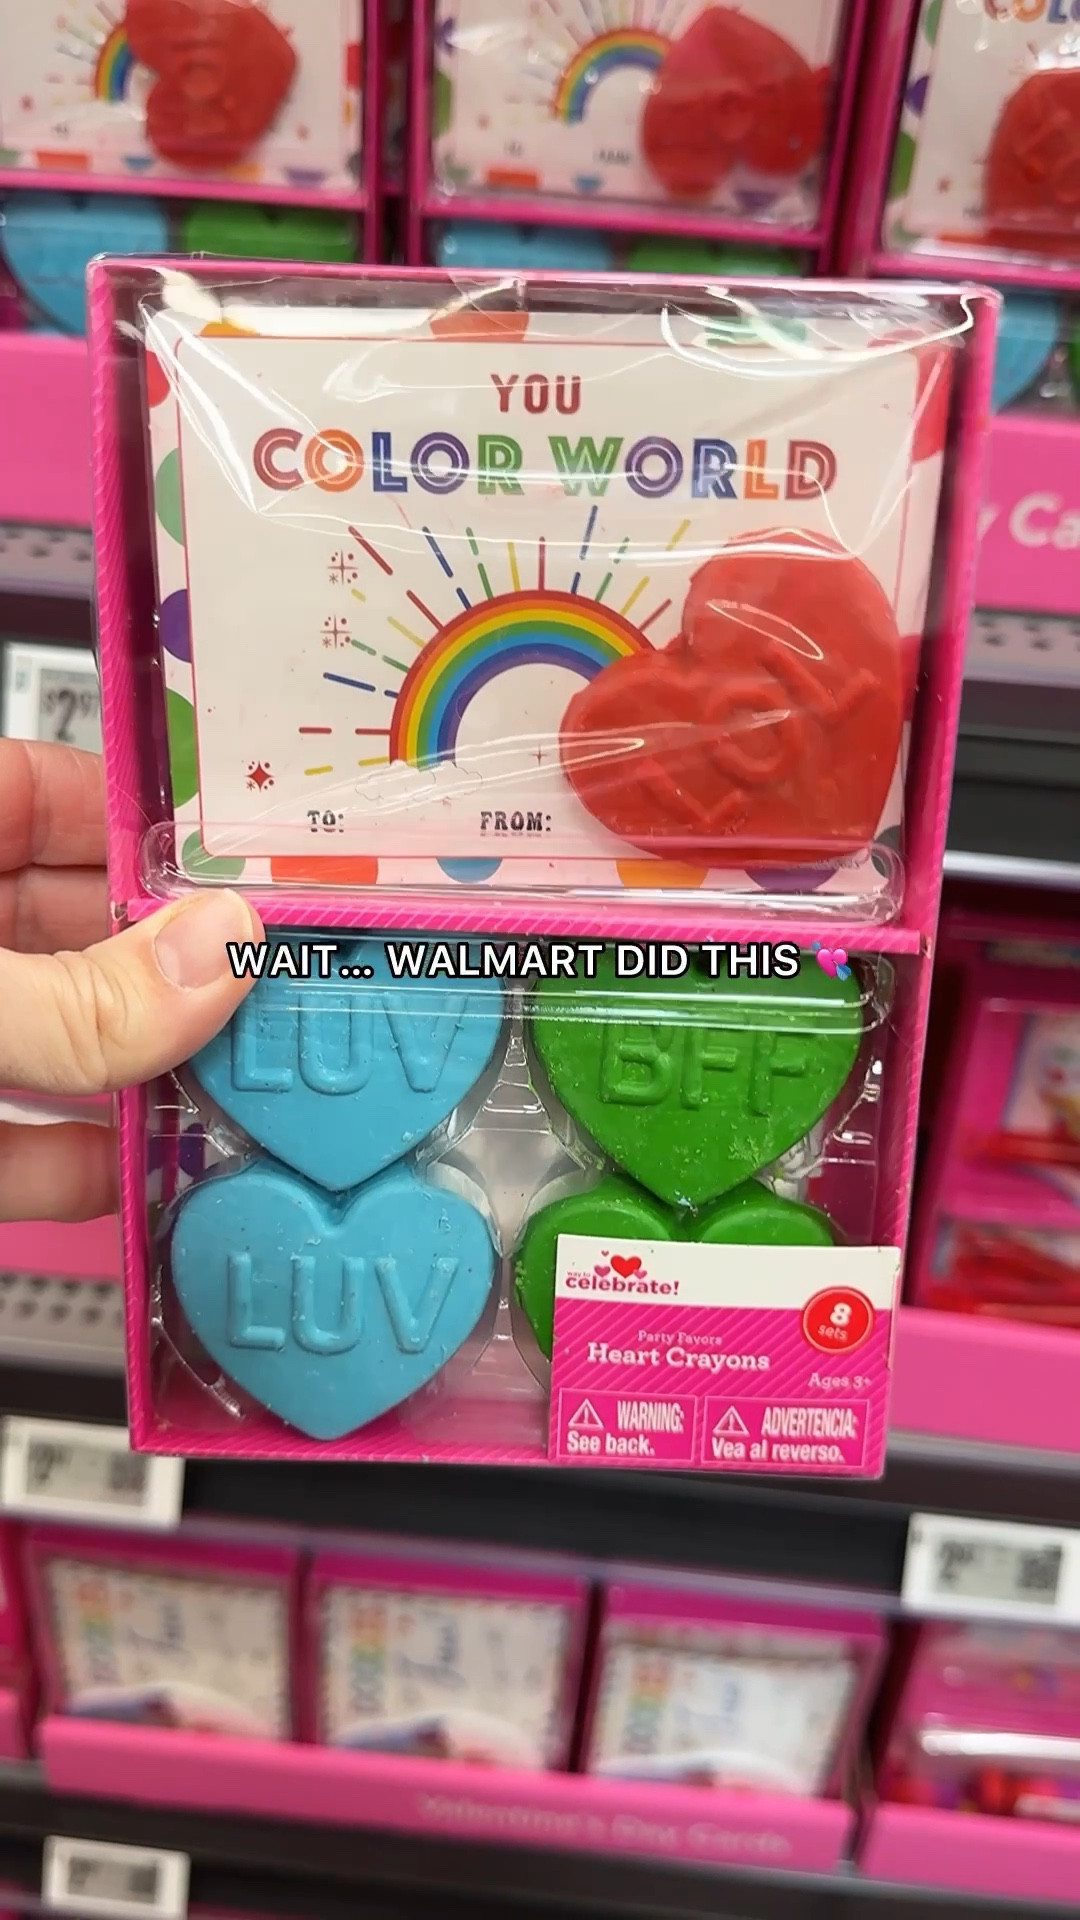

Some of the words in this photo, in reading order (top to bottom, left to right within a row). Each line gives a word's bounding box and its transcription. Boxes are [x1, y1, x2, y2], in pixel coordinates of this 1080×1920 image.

[490, 373, 582, 415] YOU
[252, 427, 524, 497] COLOR
[548, 434, 838, 501] WORLD
[307, 810, 345, 833] TO:
[479, 810, 552, 833] FROM:
[230, 992, 468, 1096] LUV
[565, 1275, 680, 1296] celebrate!
[227, 1253, 460, 1355] LUV
[829, 1302, 852, 1327] 8
[637, 1329, 675, 1345] Party
[677, 1331, 723, 1346] Favors
[818, 1323, 848, 1341] sets
[587, 1342, 660, 1366] Heart
[666, 1347, 771, 1374] Crayons
[808, 1371, 849, 1390] Ages
[852, 1376, 872, 1388] 3+
[617, 1400, 684, 1434] WARNING:
[761, 1406, 857, 1440] ADVERTENCIA:
[567, 1430, 601, 1453] See
[605, 1433, 655, 1456] back.
[712, 1437, 745, 1459] Vea
[750, 1440, 768, 1459] al
[771, 1442, 845, 1463] reverso.
